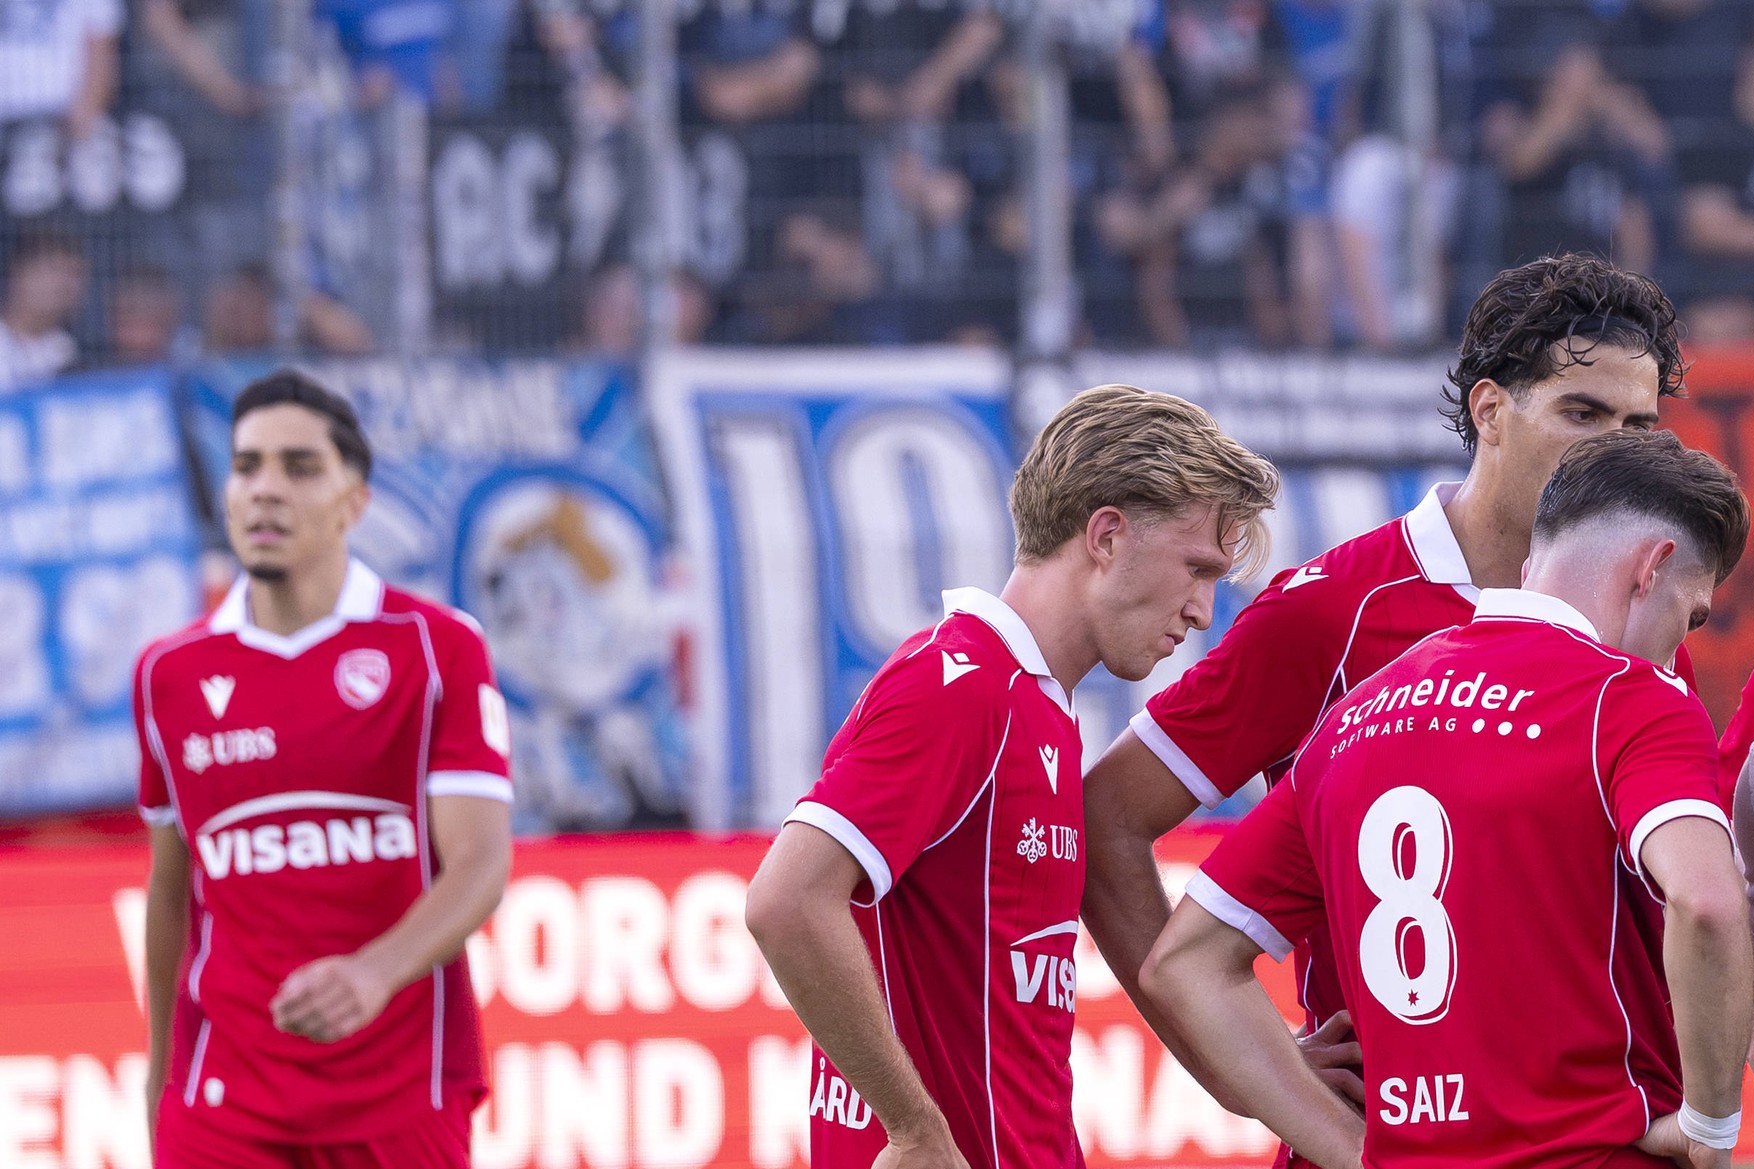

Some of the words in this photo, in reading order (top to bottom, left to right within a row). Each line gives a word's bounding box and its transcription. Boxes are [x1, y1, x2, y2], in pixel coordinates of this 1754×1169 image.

[211, 726, 277, 765] UBS
[1330, 717, 1415, 759] SOFTWARE
[1429, 717, 1457, 732] AG
[1050, 825, 1078, 862] UBS
[1358, 785, 1458, 1025] 8
[1379, 1073, 1469, 1125] SAIZ
